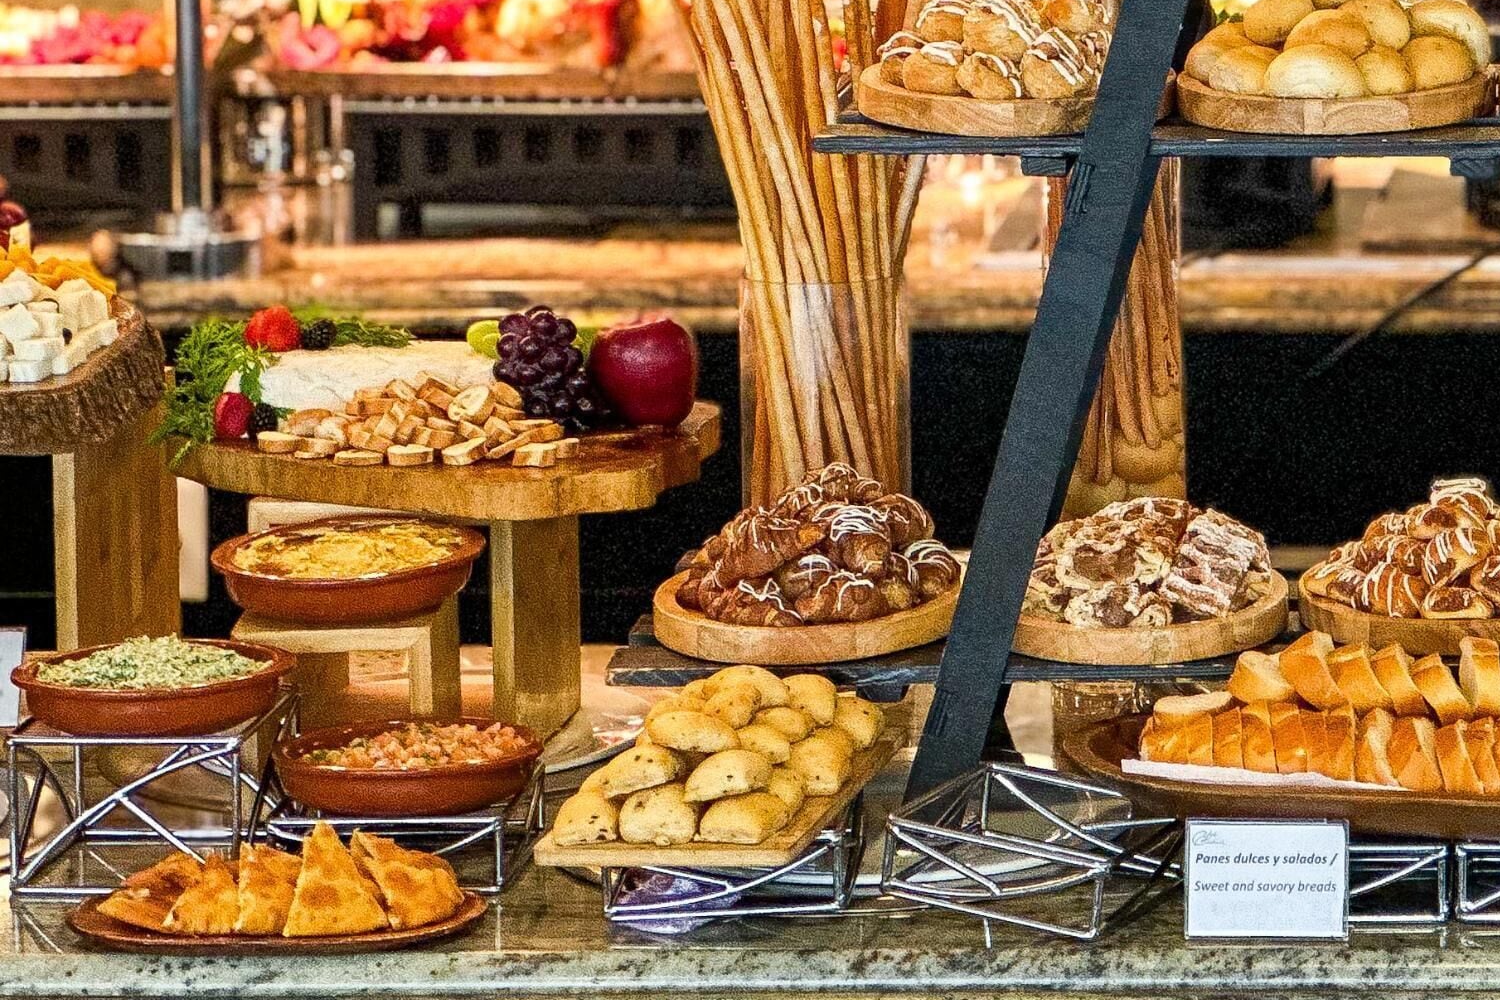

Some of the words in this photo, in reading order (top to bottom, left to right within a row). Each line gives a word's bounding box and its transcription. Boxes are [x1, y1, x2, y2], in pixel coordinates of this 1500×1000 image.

[1195, 853, 1230, 864] Panes
[1233, 852, 1270, 864] dulces
[1272, 855, 1281, 867] y
[1282, 852, 1328, 865] salados
[1329, 852, 1339, 866] /
[1194, 880, 1229, 892] Sweet
[1232, 880, 1254, 892] and
[1257, 883, 1295, 895] savory
[1297, 880, 1337, 892] breads
